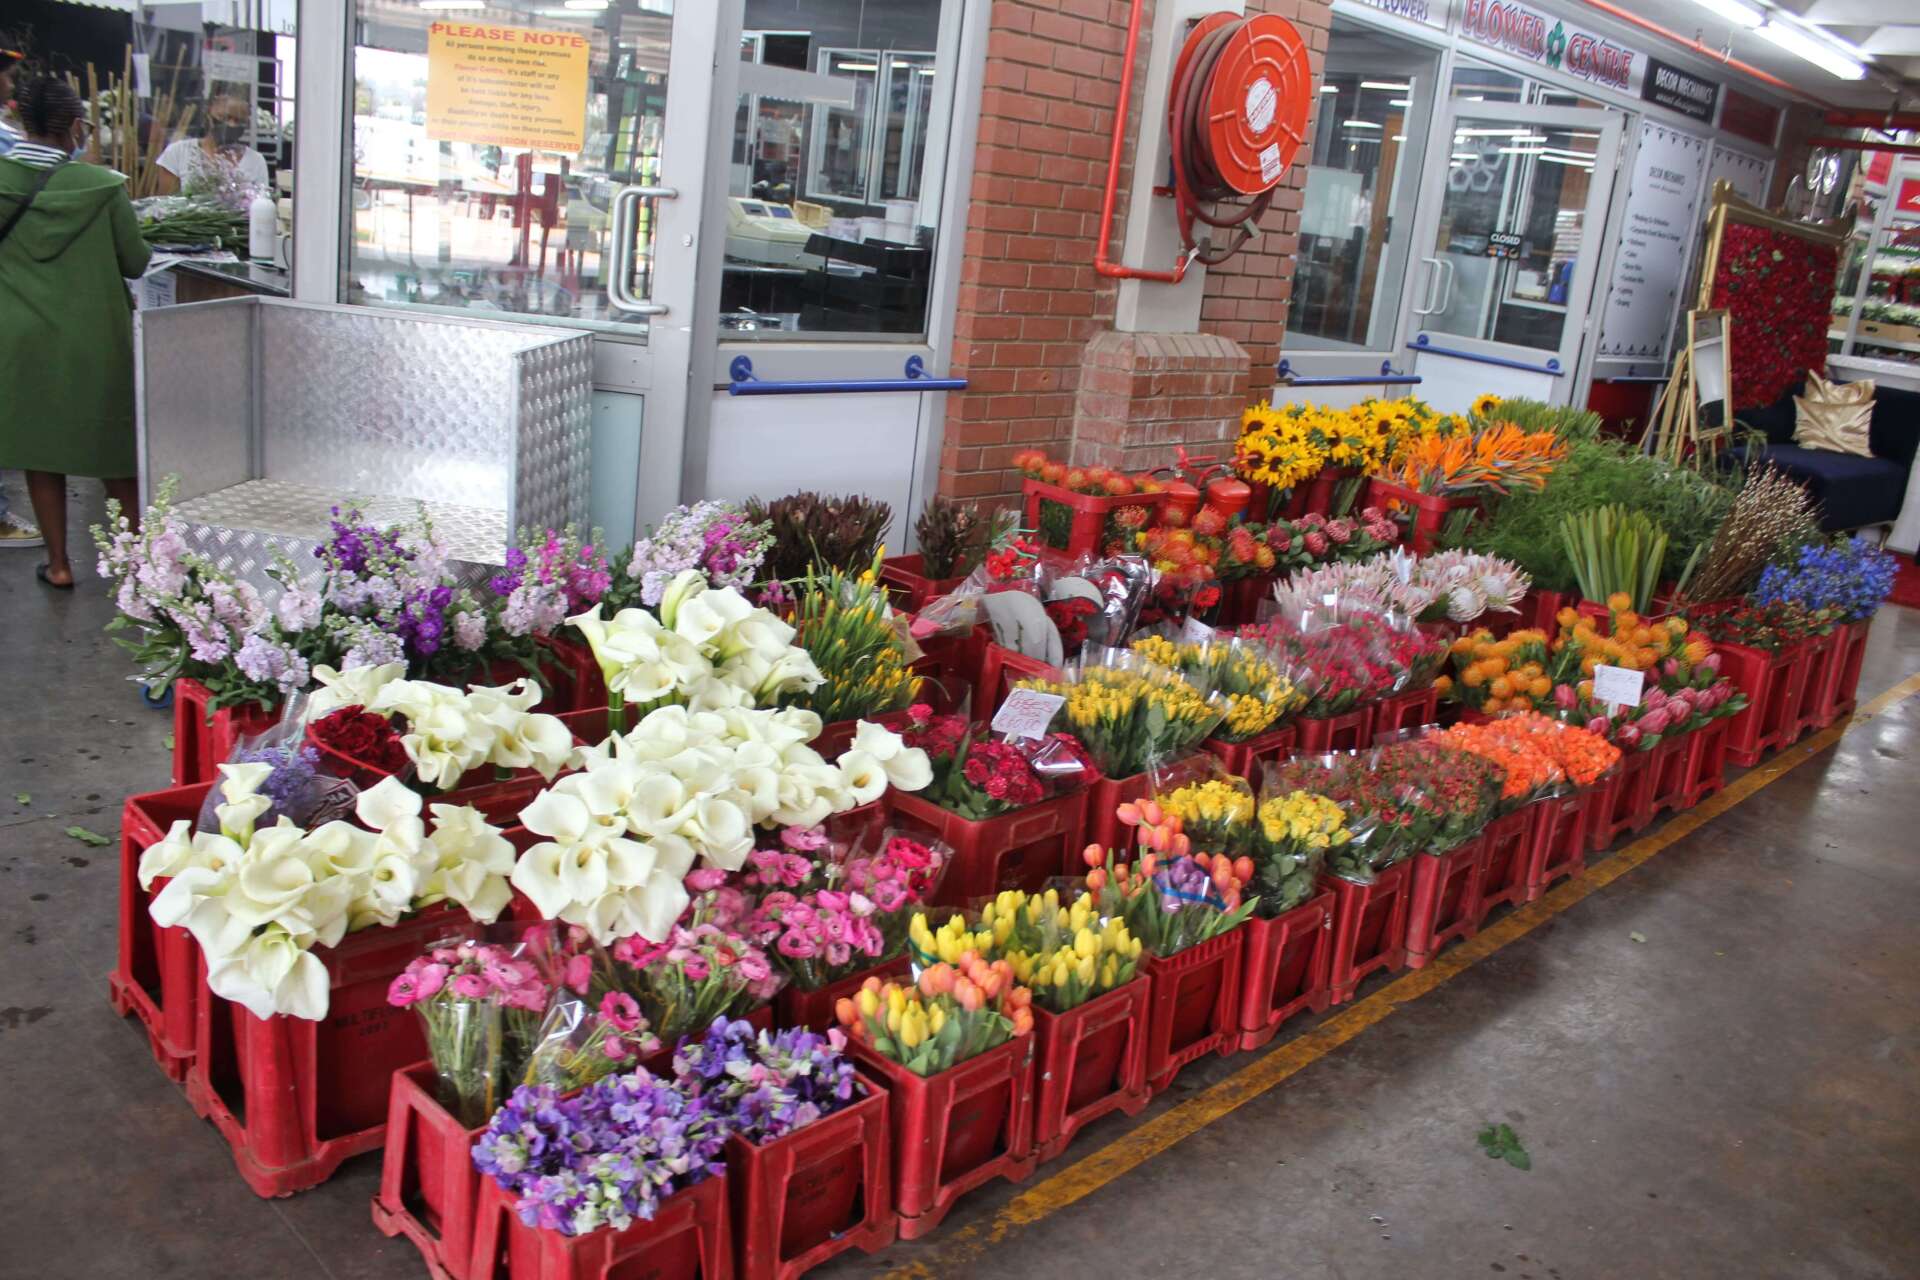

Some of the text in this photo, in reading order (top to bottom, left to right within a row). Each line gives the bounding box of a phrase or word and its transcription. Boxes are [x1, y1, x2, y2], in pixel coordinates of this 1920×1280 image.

[431, 22, 584, 48] PLEASE NOTE
[1463, 0, 1634, 90] FLOWER CENTRE
[1656, 68, 1679, 91] DECOR
